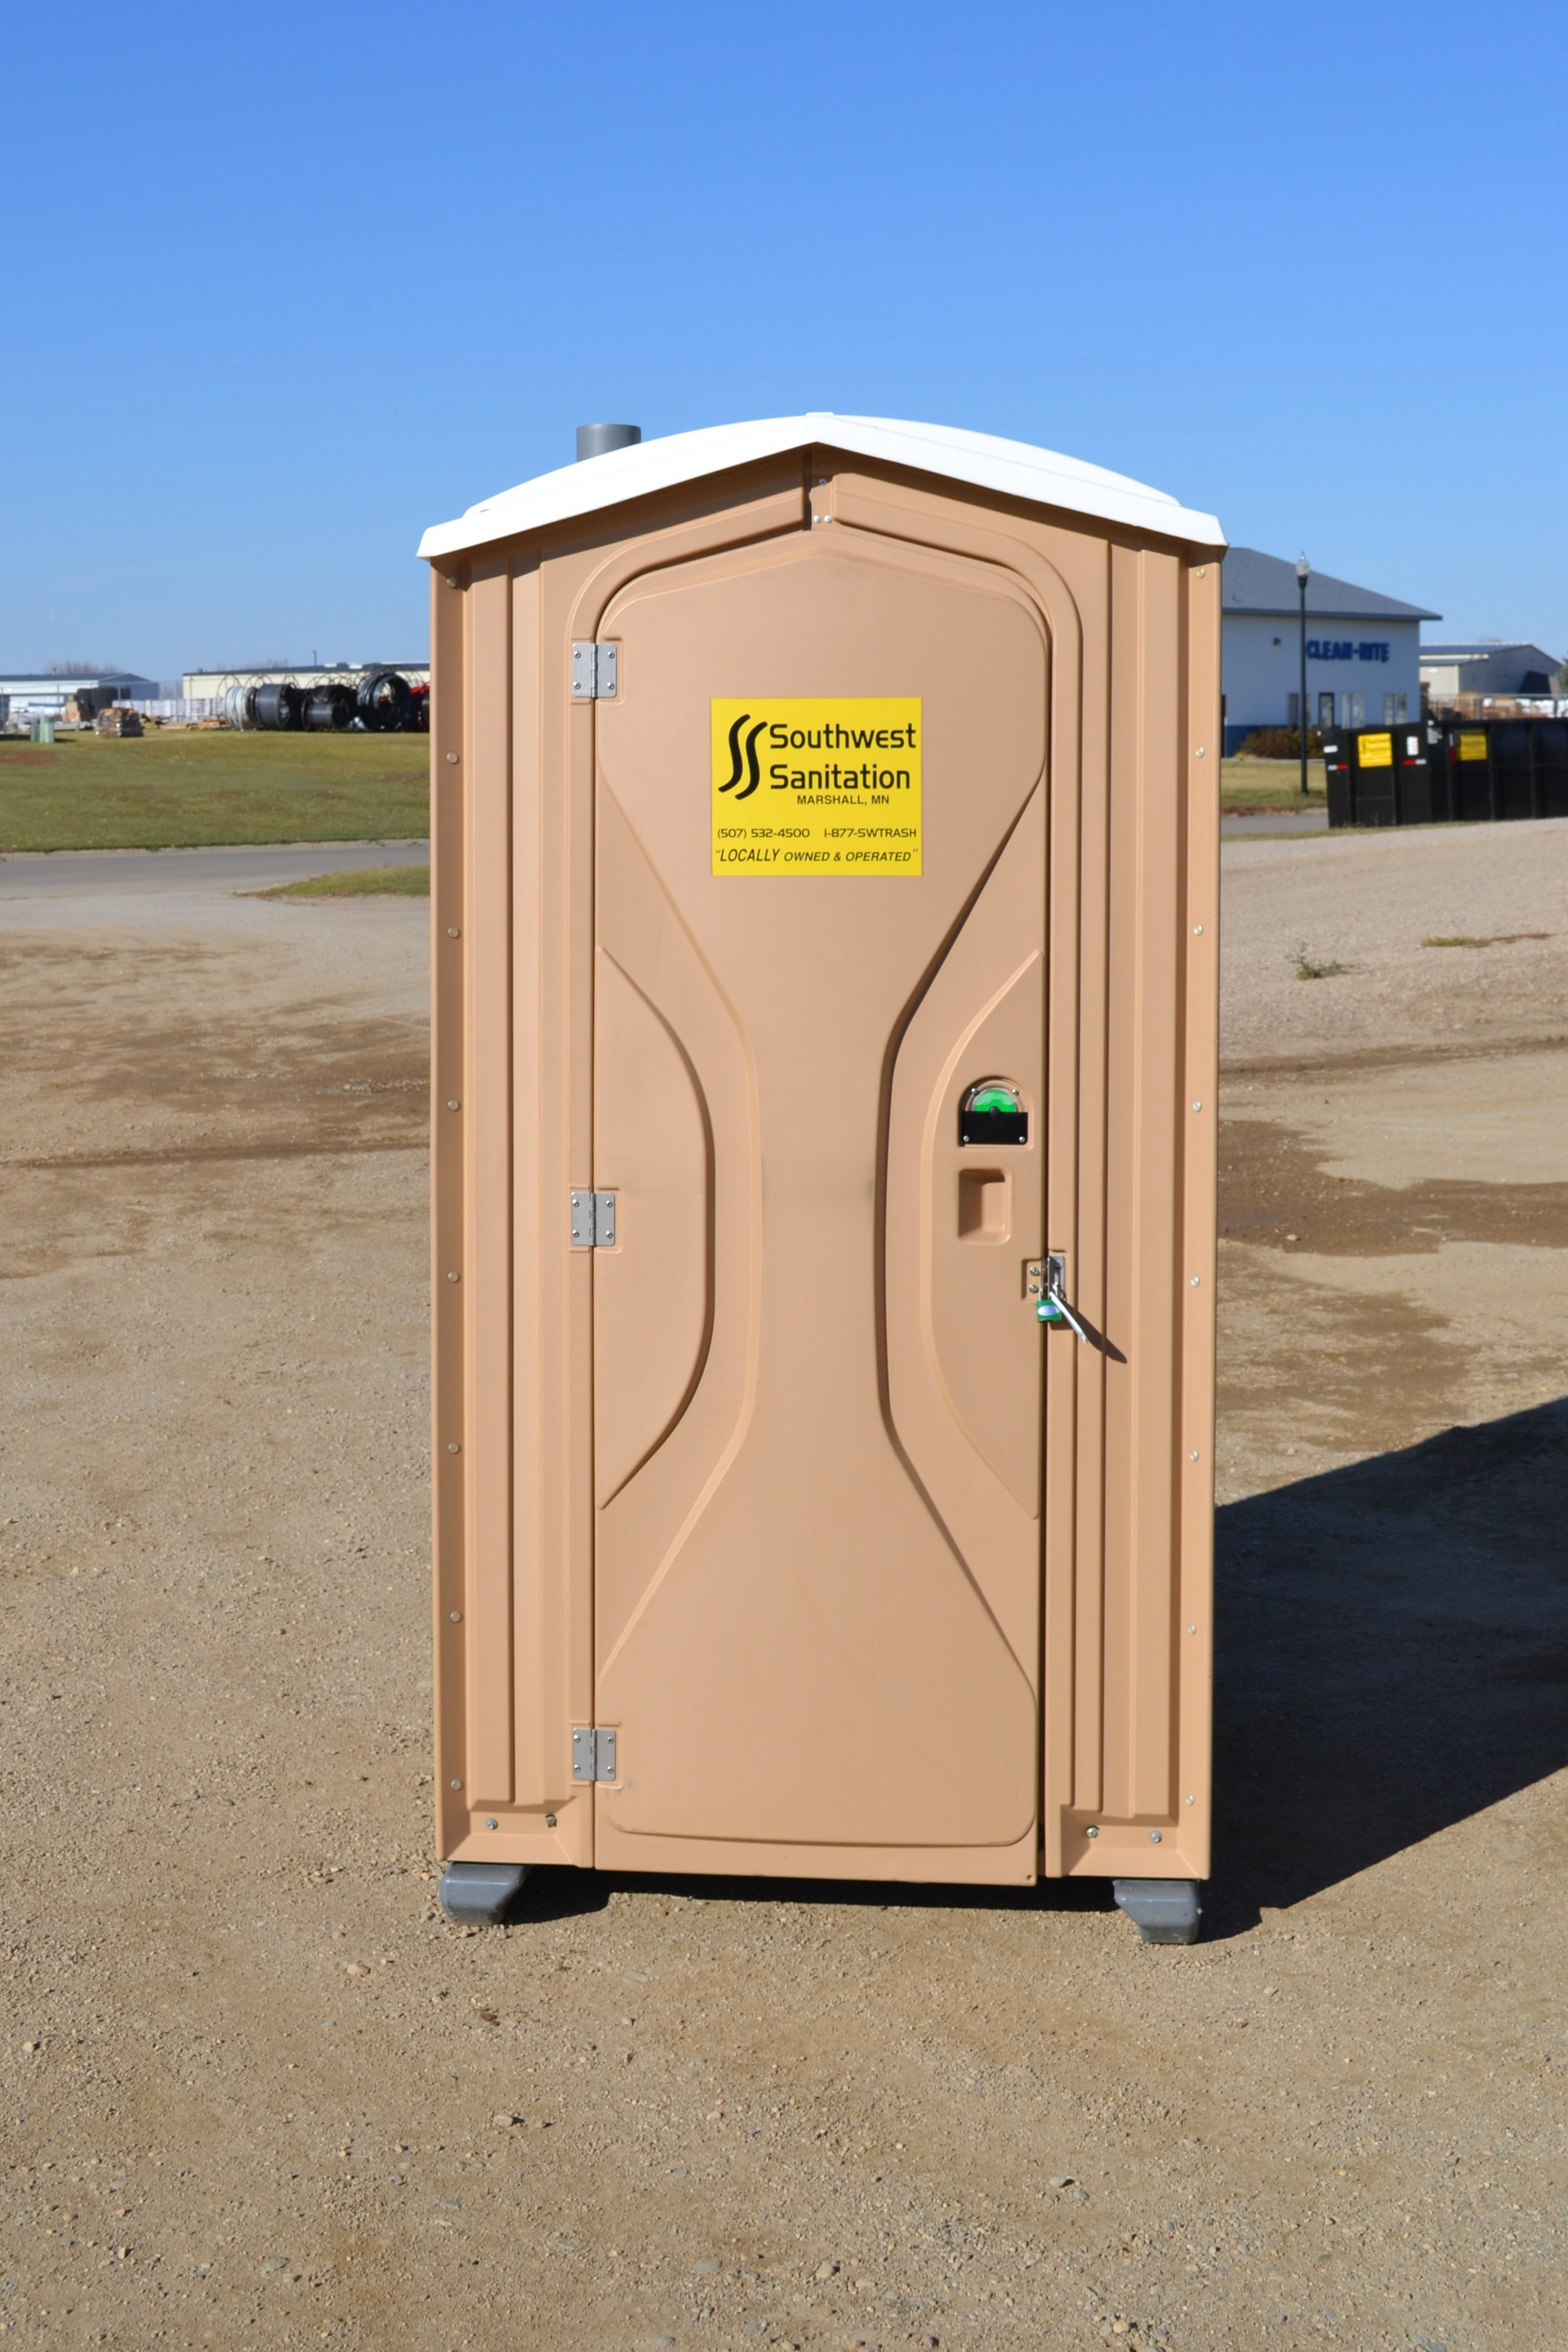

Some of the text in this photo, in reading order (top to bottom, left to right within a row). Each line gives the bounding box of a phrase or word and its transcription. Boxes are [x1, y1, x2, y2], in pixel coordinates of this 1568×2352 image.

[769, 723, 916, 749] Southwest
[769, 764, 911, 790] Sanitation
[797, 795, 889, 806] MARSHALL, MN
[717, 828, 916, 840] (507) 532-4500 1-877-SWTRASH
[783, 852, 830, 862] OWNED
[833, 852, 842, 862] &
